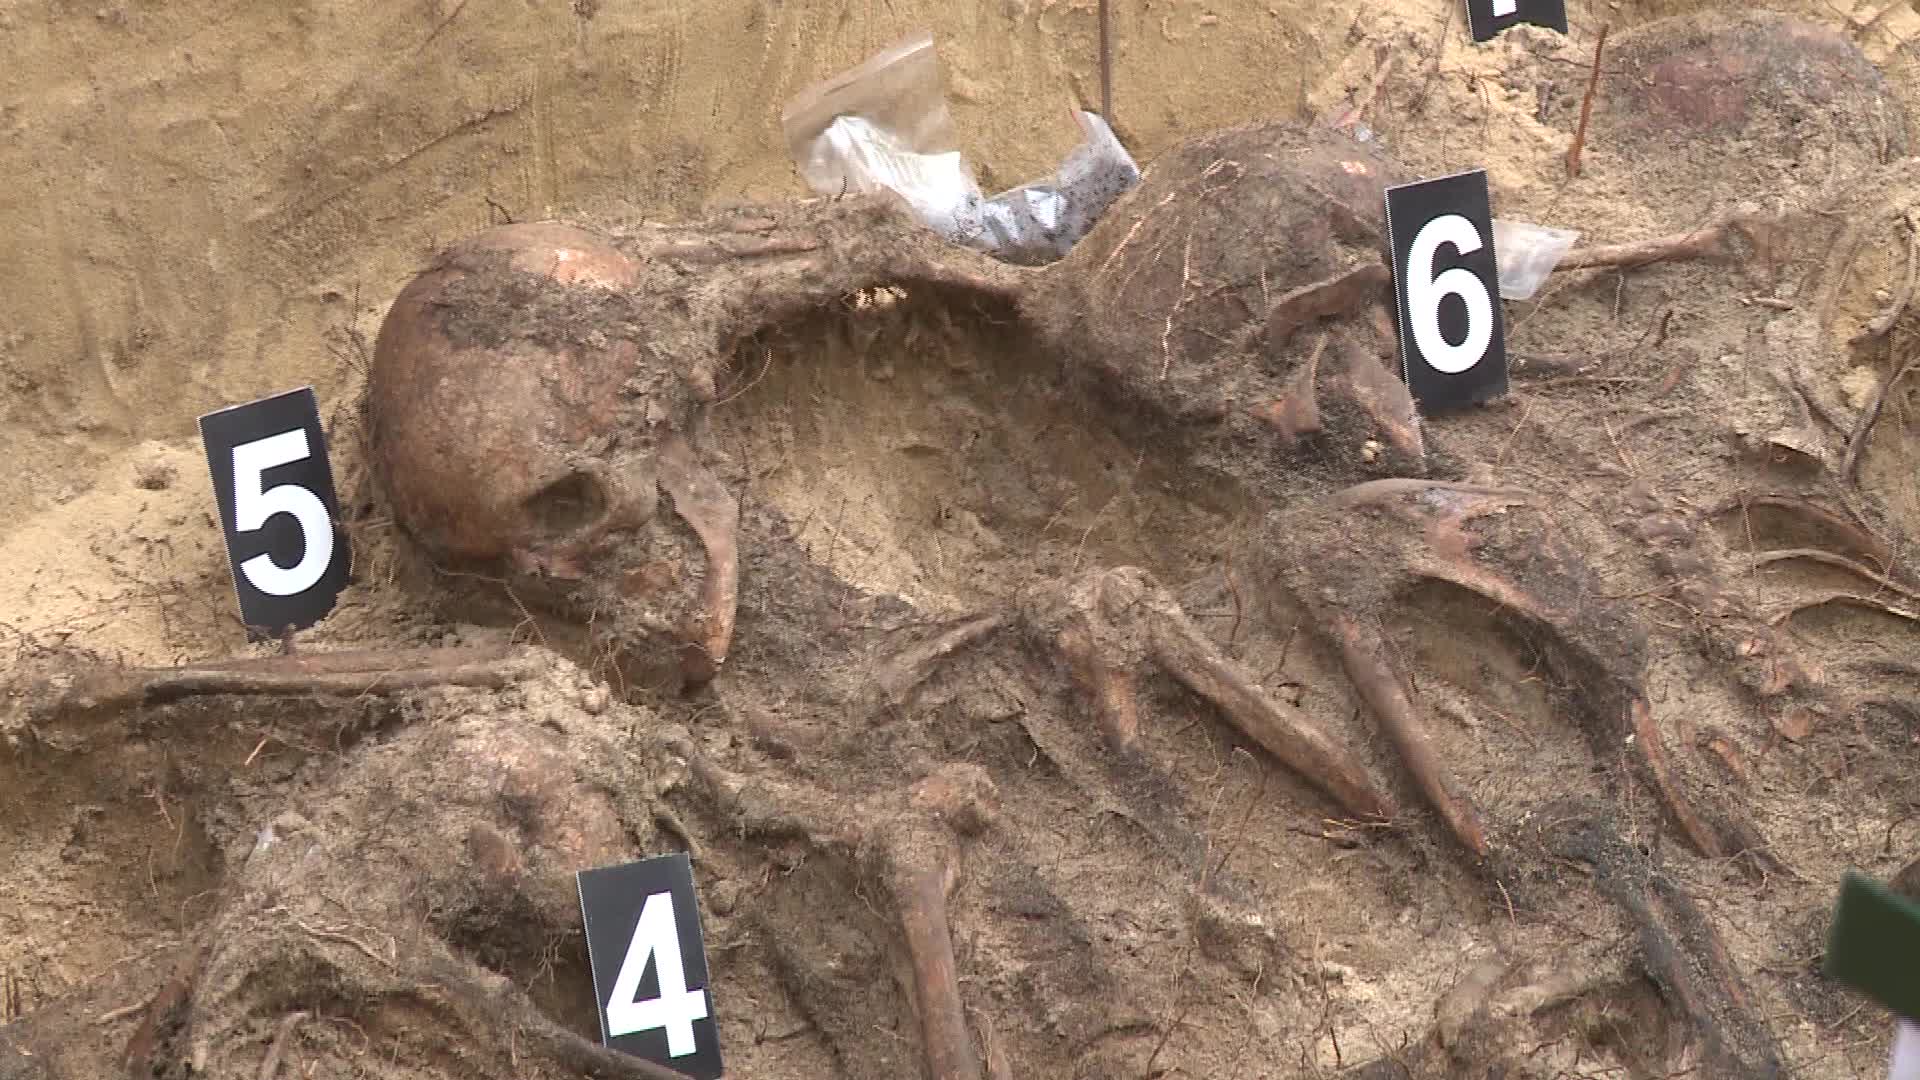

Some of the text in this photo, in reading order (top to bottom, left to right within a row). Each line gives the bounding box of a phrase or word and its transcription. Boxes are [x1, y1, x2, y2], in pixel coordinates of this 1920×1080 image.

[1407, 214, 1494, 374] 6
[231, 428, 334, 597] 5
[605, 890, 708, 1058] 4
